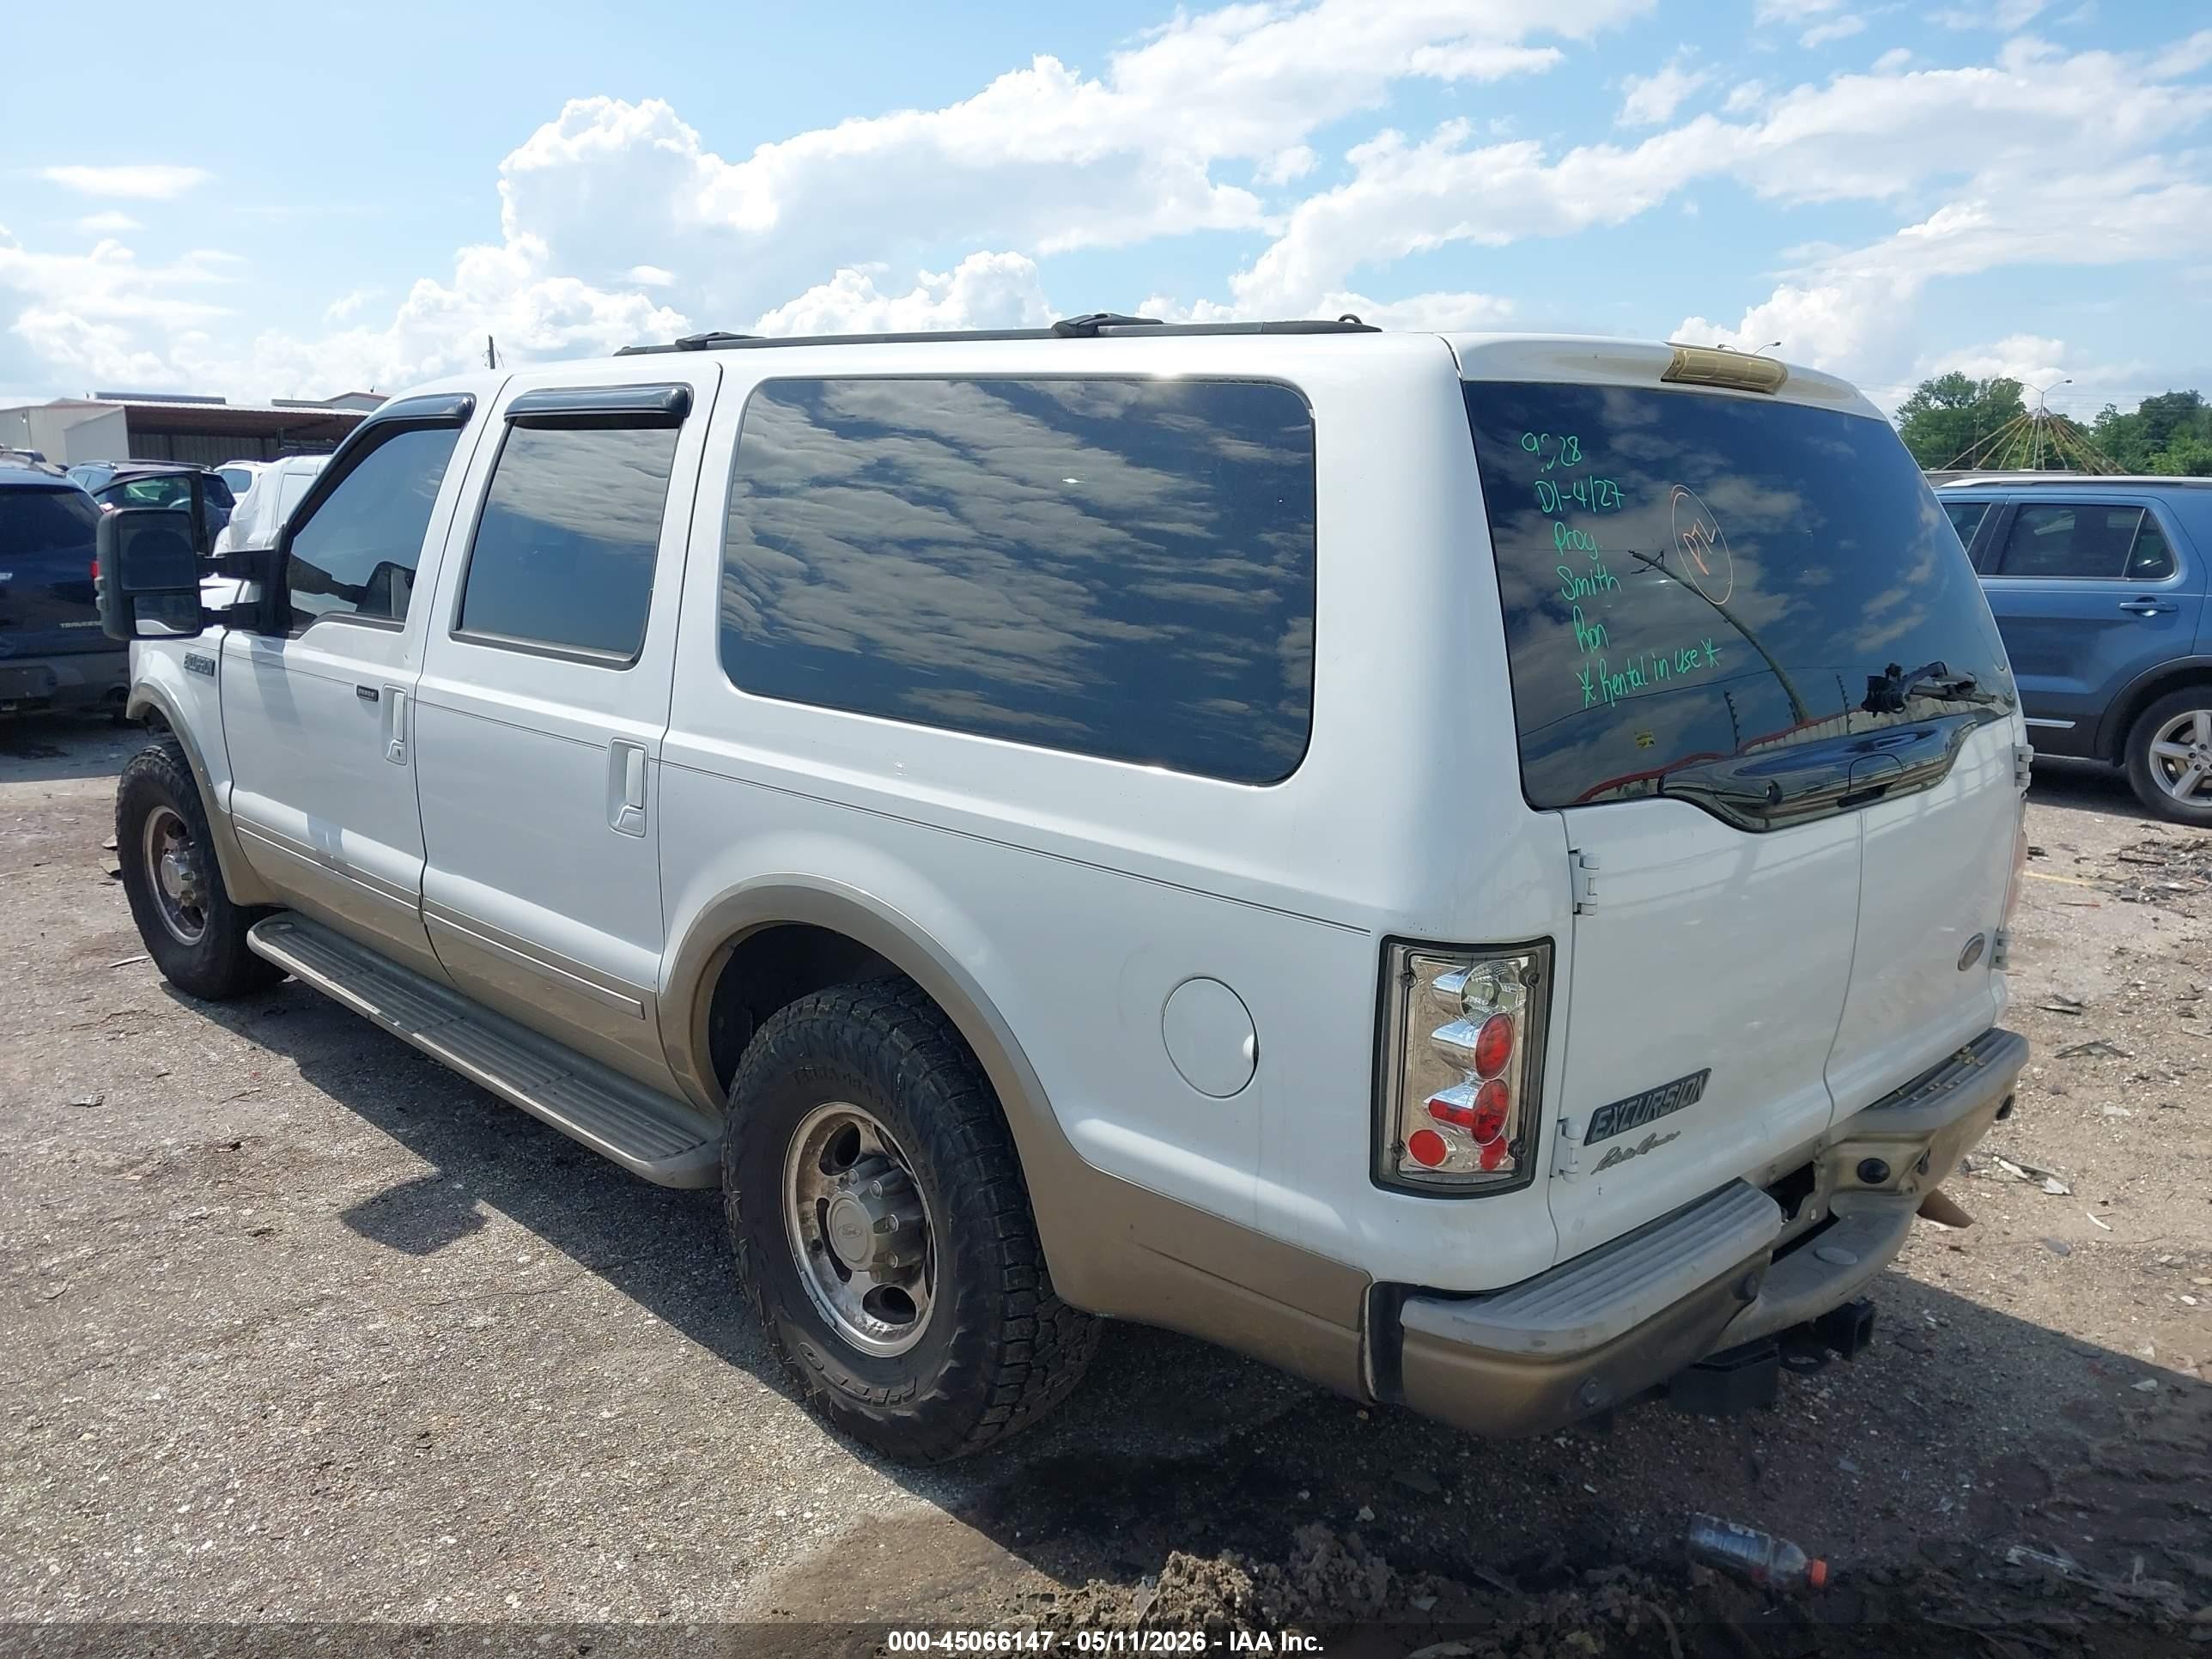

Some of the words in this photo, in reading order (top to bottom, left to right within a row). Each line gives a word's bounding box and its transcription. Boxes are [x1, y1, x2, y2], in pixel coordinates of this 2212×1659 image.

[1557, 563, 1622, 601] Smith
[1572, 605, 1610, 653] Ron
[1599, 658, 1649, 708] Rental
[1650, 652, 1671, 681] in
[1590, 1076, 1708, 1142] EXCURSION
